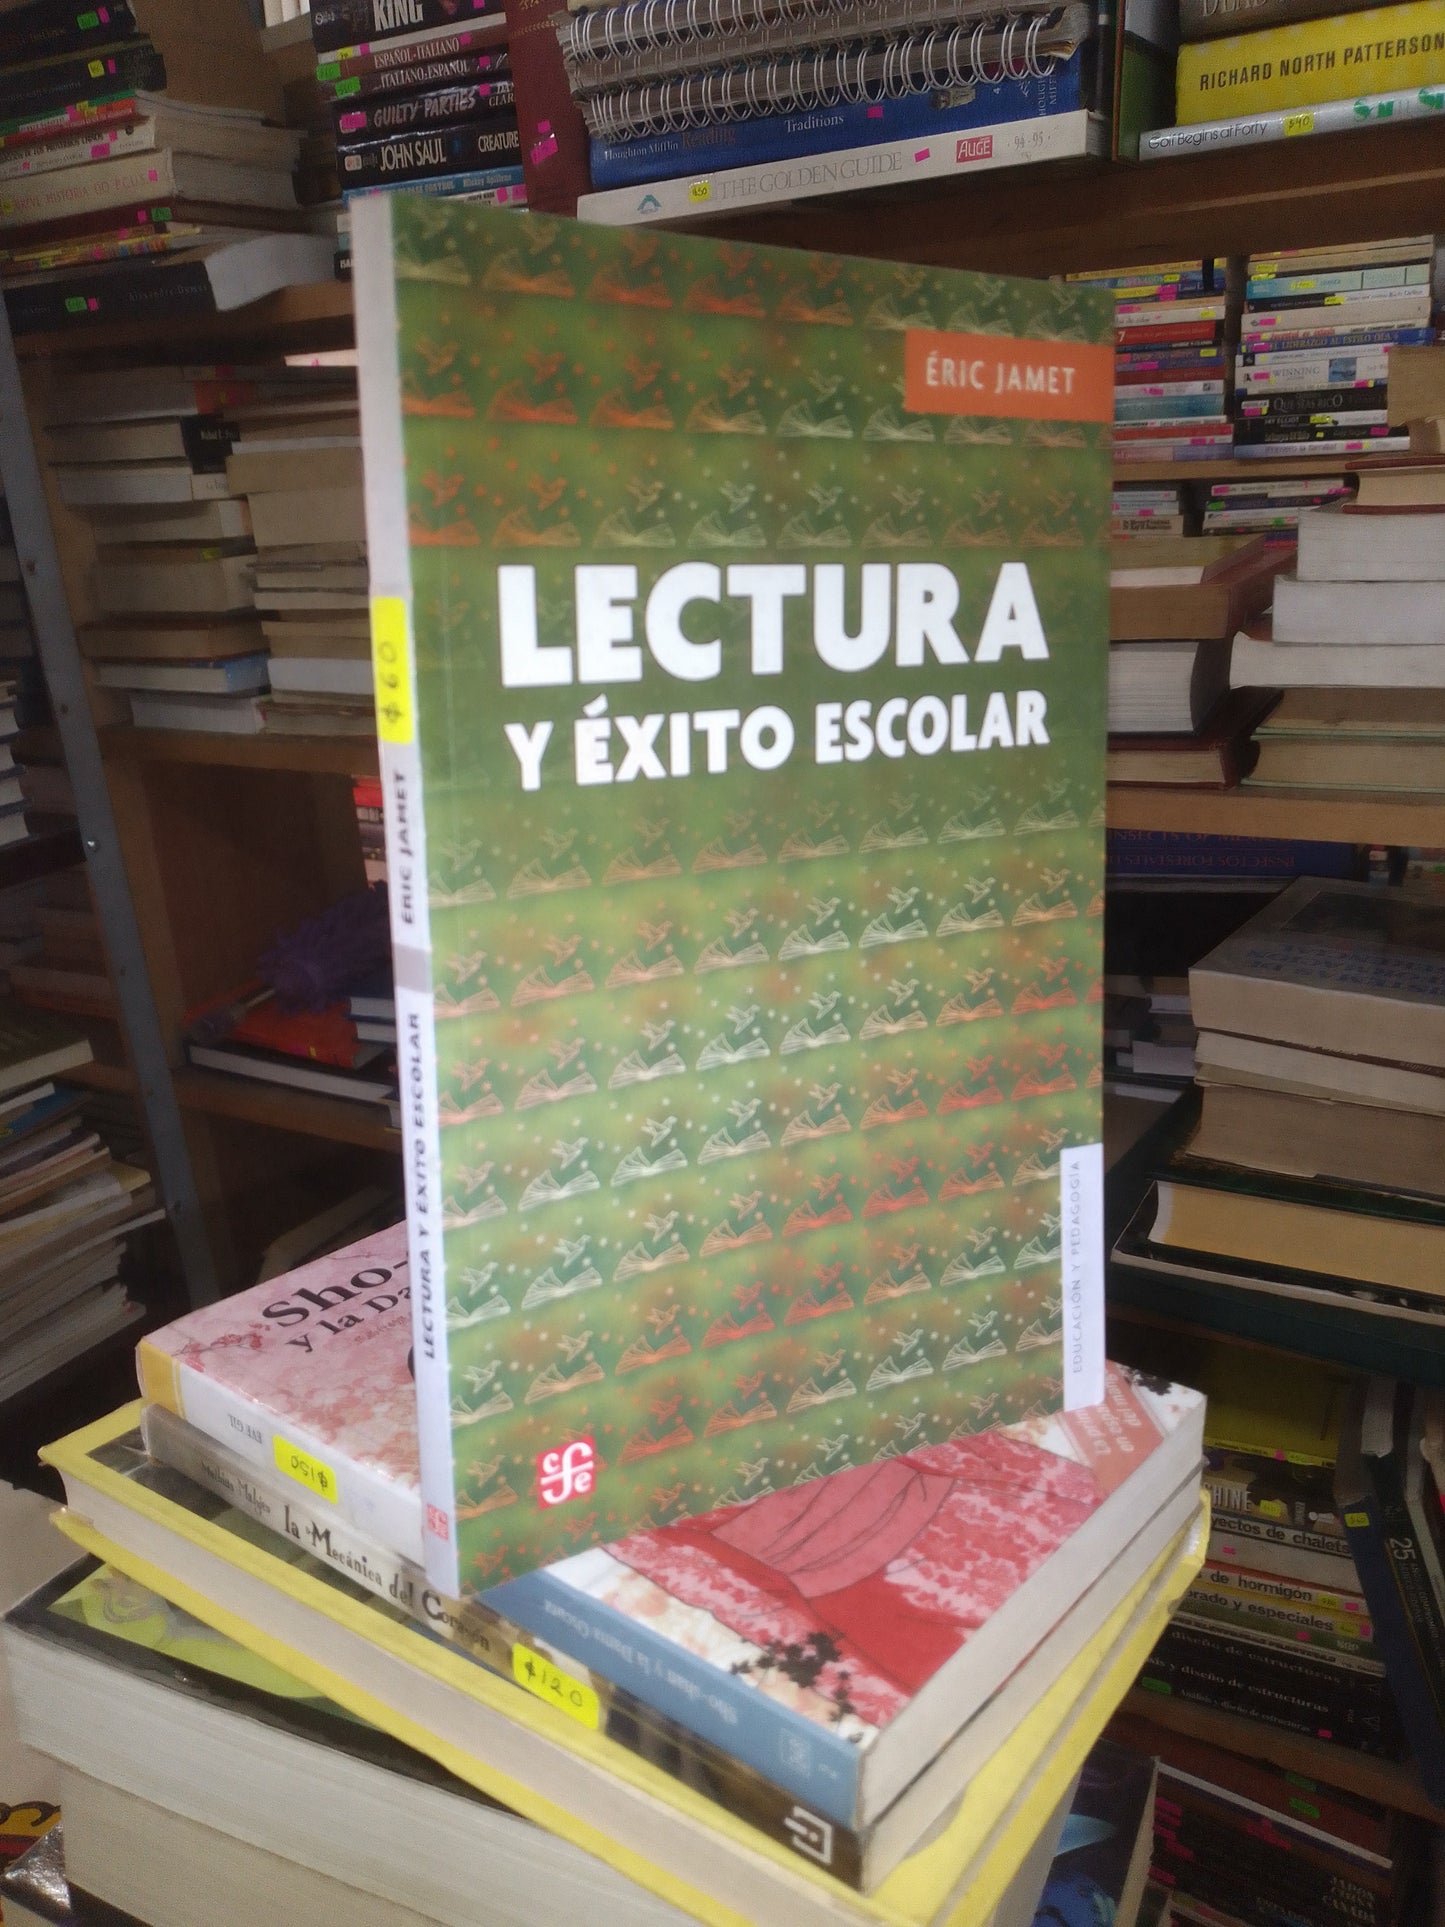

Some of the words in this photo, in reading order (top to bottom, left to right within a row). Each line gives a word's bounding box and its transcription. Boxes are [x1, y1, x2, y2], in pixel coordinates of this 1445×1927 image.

[373, 0, 424, 31] KING
[1200, 62, 1272, 91] RICHARD
[1280, 51, 1335, 78] NORTH
[1343, 33, 1445, 65] PATTERSON
[374, 103, 422, 127] GUILTY
[424, 91, 477, 118] PARTIES
[489, 92, 514, 107] CLAR
[478, 130, 520, 153] CREATURE
[681, 127, 736, 150] Reading
[784, 113, 844, 133] Traditions
[1177, 125, 1218, 146] Begins
[1235, 120, 1267, 138] Forty
[379, 144, 414, 172] JOHN
[415, 139, 447, 165] SAUL
[604, 147, 647, 162] Houghton
[649, 141, 679, 154] Mifflin
[719, 177, 757, 200] THE
[759, 161, 839, 193] GOLDEN
[840, 151, 903, 178] GUIDE
[926, 350, 985, 390] ÉRIC
[995, 363, 1076, 395] JAMET
[497, 561, 1050, 688] LECTURA
[504, 720, 554, 791] Y
[574, 693, 795, 785] ÉXITO
[815, 689, 1050, 764] ESCOLAR
[393, 771, 413, 857] JAMET
[407, 1012, 427, 1129] ESCOLAR
[1069, 1160, 1081, 1256] PEDAGOGÍA
[417, 1227, 431, 1240] Y
[1071, 1262, 1081, 1273] Y
[262, 1260, 408, 1328] Sho-
[415, 1248, 435, 1361] LECTURA
[285, 1333, 313, 1353] y
[316, 1314, 364, 1335] la
[362, 1286, 410, 1313] Da
[1071, 1277, 1083, 1374] EDUCACIÓN
[290, 1455, 328, 1490] $150
[284, 1504, 300, 1539] la
[1212, 1516, 1261, 1536] yectos
[1267, 1523, 1286, 1541] de
[1293, 1529, 1351, 1554] chalets
[1390, 1537, 1418, 1561] 25
[1211, 1570, 1229, 1585] de
[1187, 1590, 1229, 1607] orado
[1232, 1600, 1242, 1612] y
[1249, 1600, 1334, 1632] especiales
[524, 1658, 584, 1708] $120
